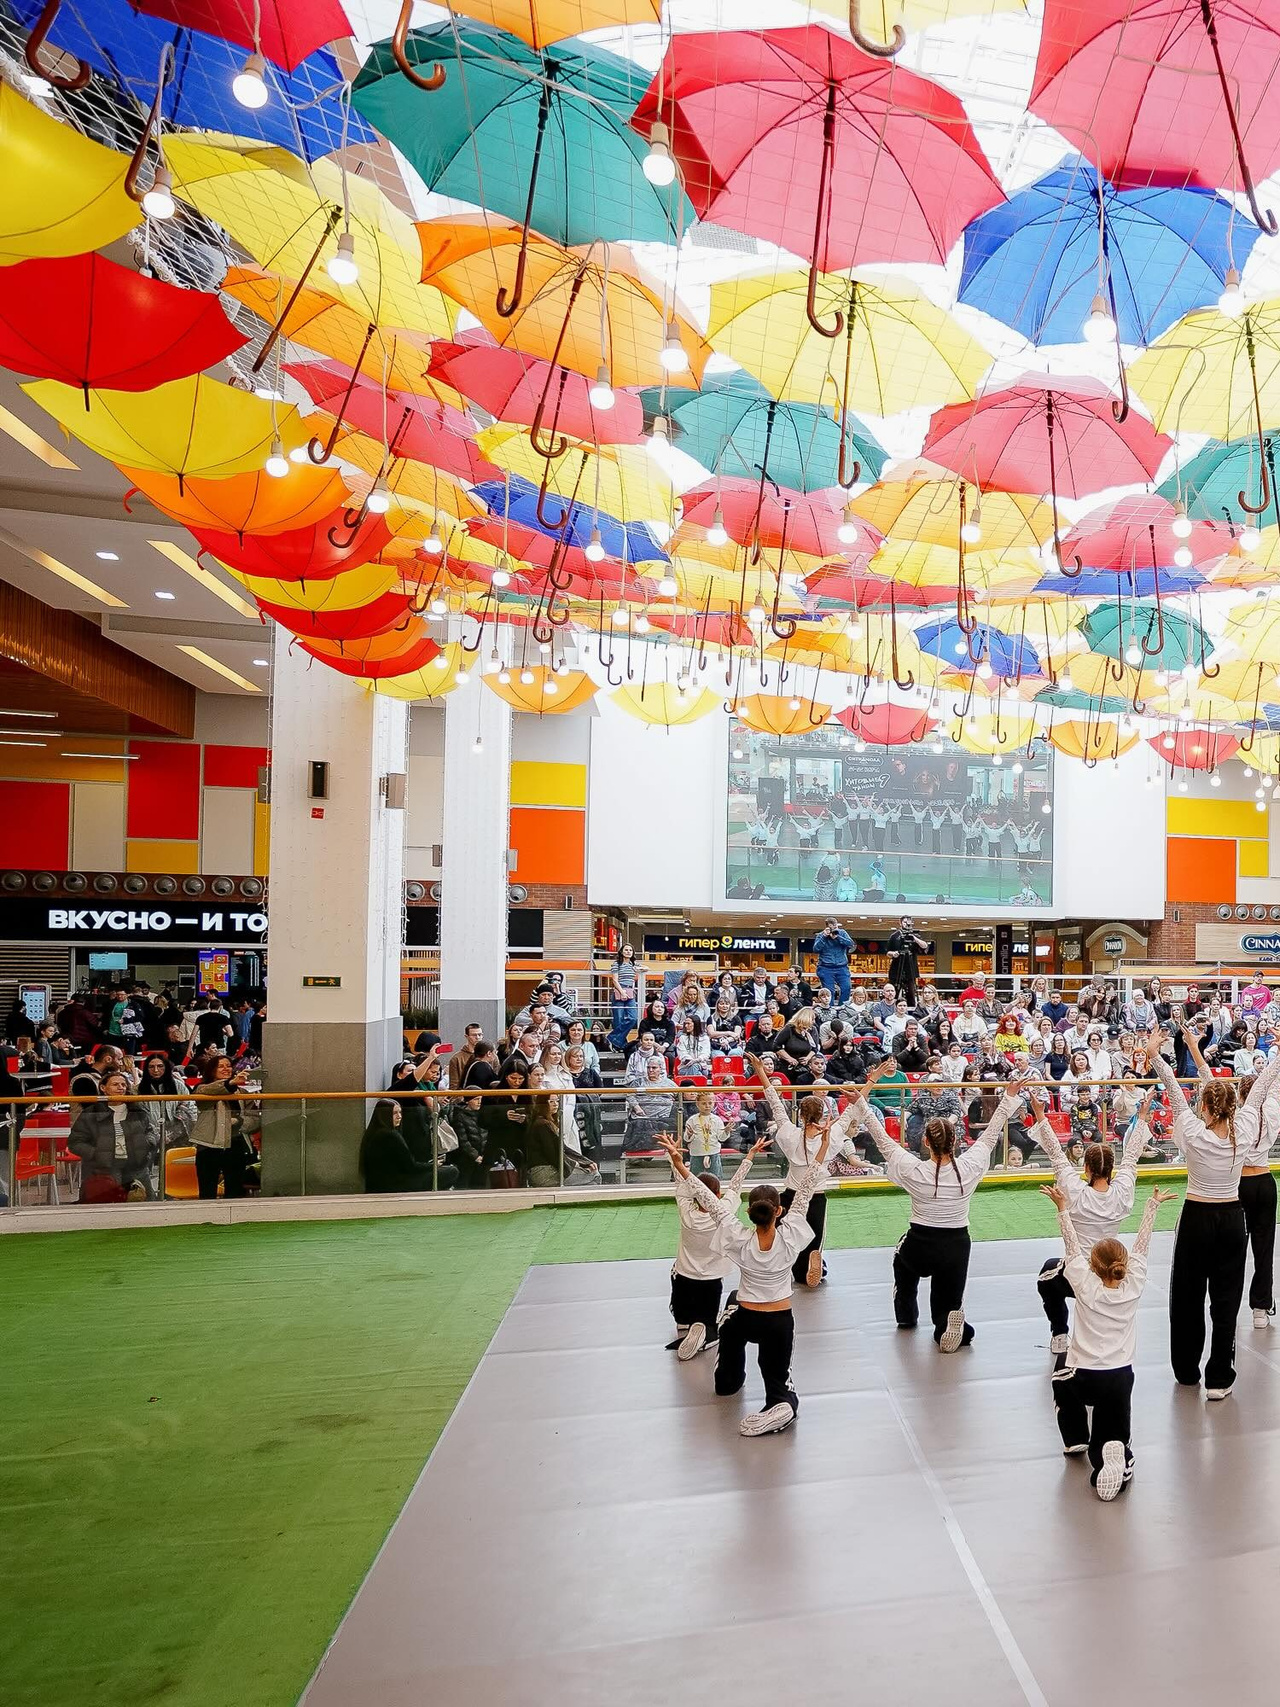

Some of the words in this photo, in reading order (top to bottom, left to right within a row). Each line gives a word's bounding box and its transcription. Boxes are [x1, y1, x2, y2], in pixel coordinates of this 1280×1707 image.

[49, 910, 171, 930] ВКУСНО
[230, 912, 269, 932] ТО
[679, 938, 720, 950] гипер
[733, 938, 776, 949] лента
[965, 943, 993, 952] гипе
[1013, 943, 1030, 953] ле
